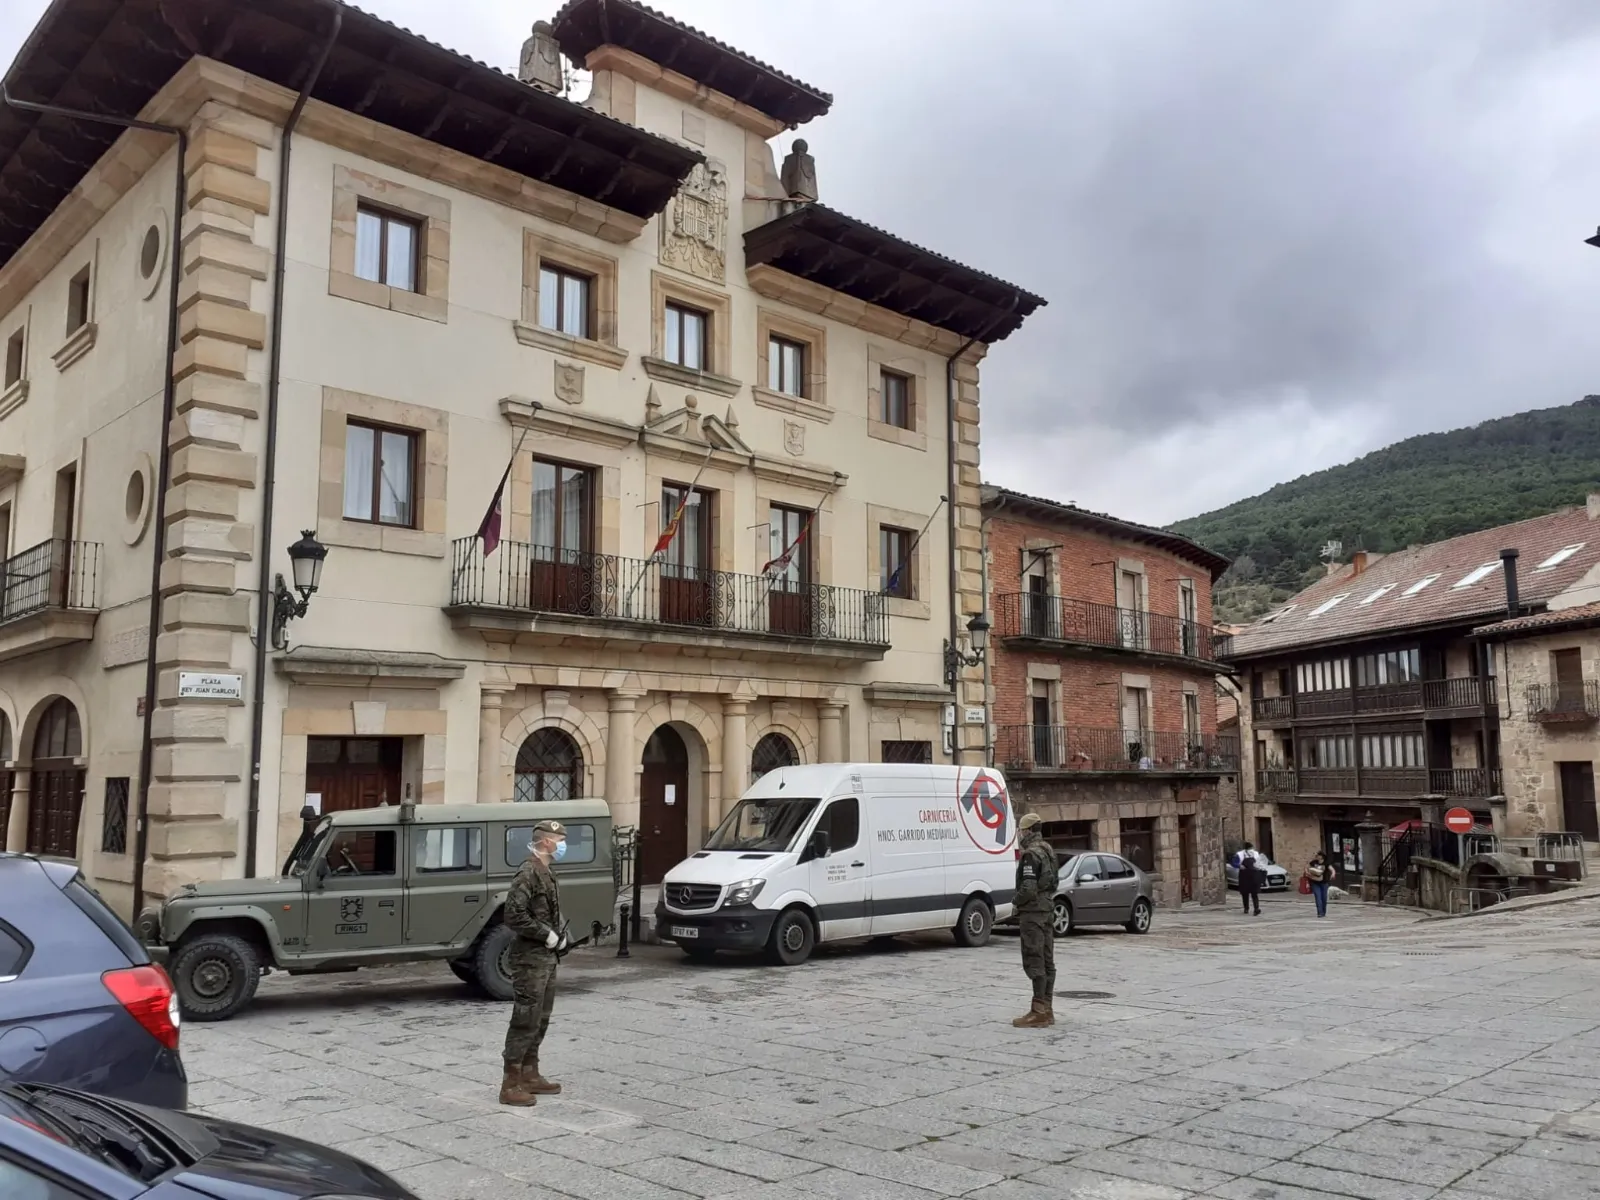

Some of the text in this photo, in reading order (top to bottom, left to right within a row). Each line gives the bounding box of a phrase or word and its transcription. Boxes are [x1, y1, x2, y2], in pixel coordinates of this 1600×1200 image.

[918, 807, 957, 823] CARNICERÍA
[878, 828, 959, 842] HNOS. GARRIDO MEDIAVILLA
